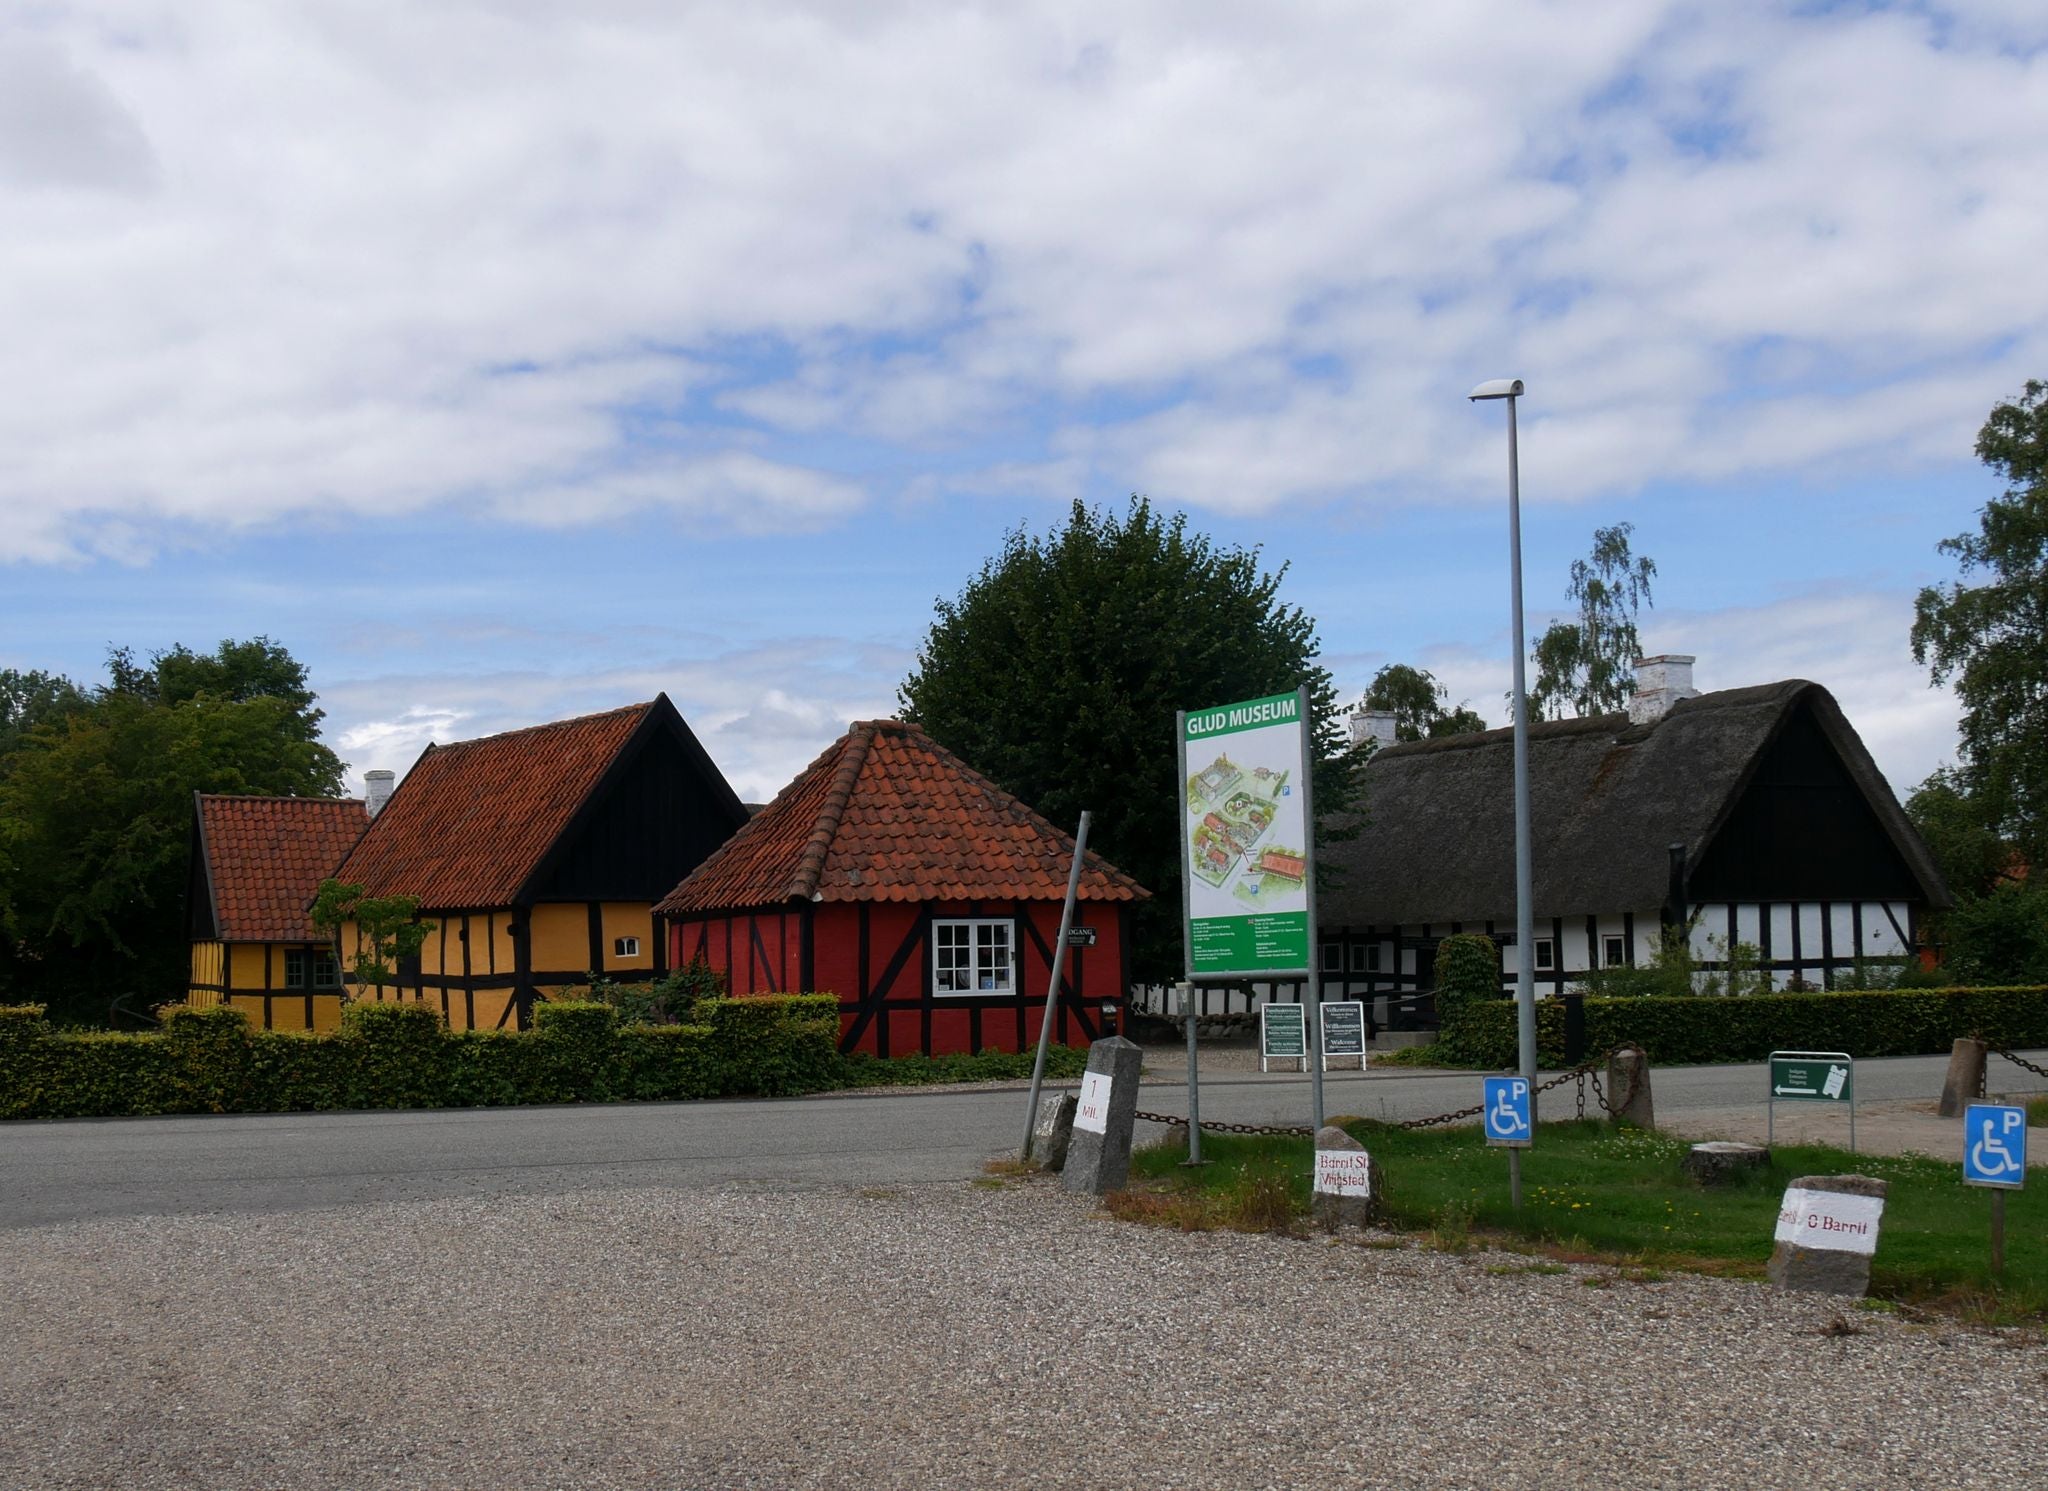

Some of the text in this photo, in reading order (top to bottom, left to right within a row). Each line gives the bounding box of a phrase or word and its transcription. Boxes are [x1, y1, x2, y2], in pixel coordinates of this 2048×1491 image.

[1187, 699, 1296, 734] GLUD MUSEUM
[1092, 1079, 1097, 1098] 1
[1512, 1081, 1526, 1100] P
[1082, 1105, 1098, 1119] MIL
[2003, 1111, 2021, 1134] P
[1320, 1155, 1353, 1168] Barrit
[1823, 1216, 1867, 1234] Barrit
